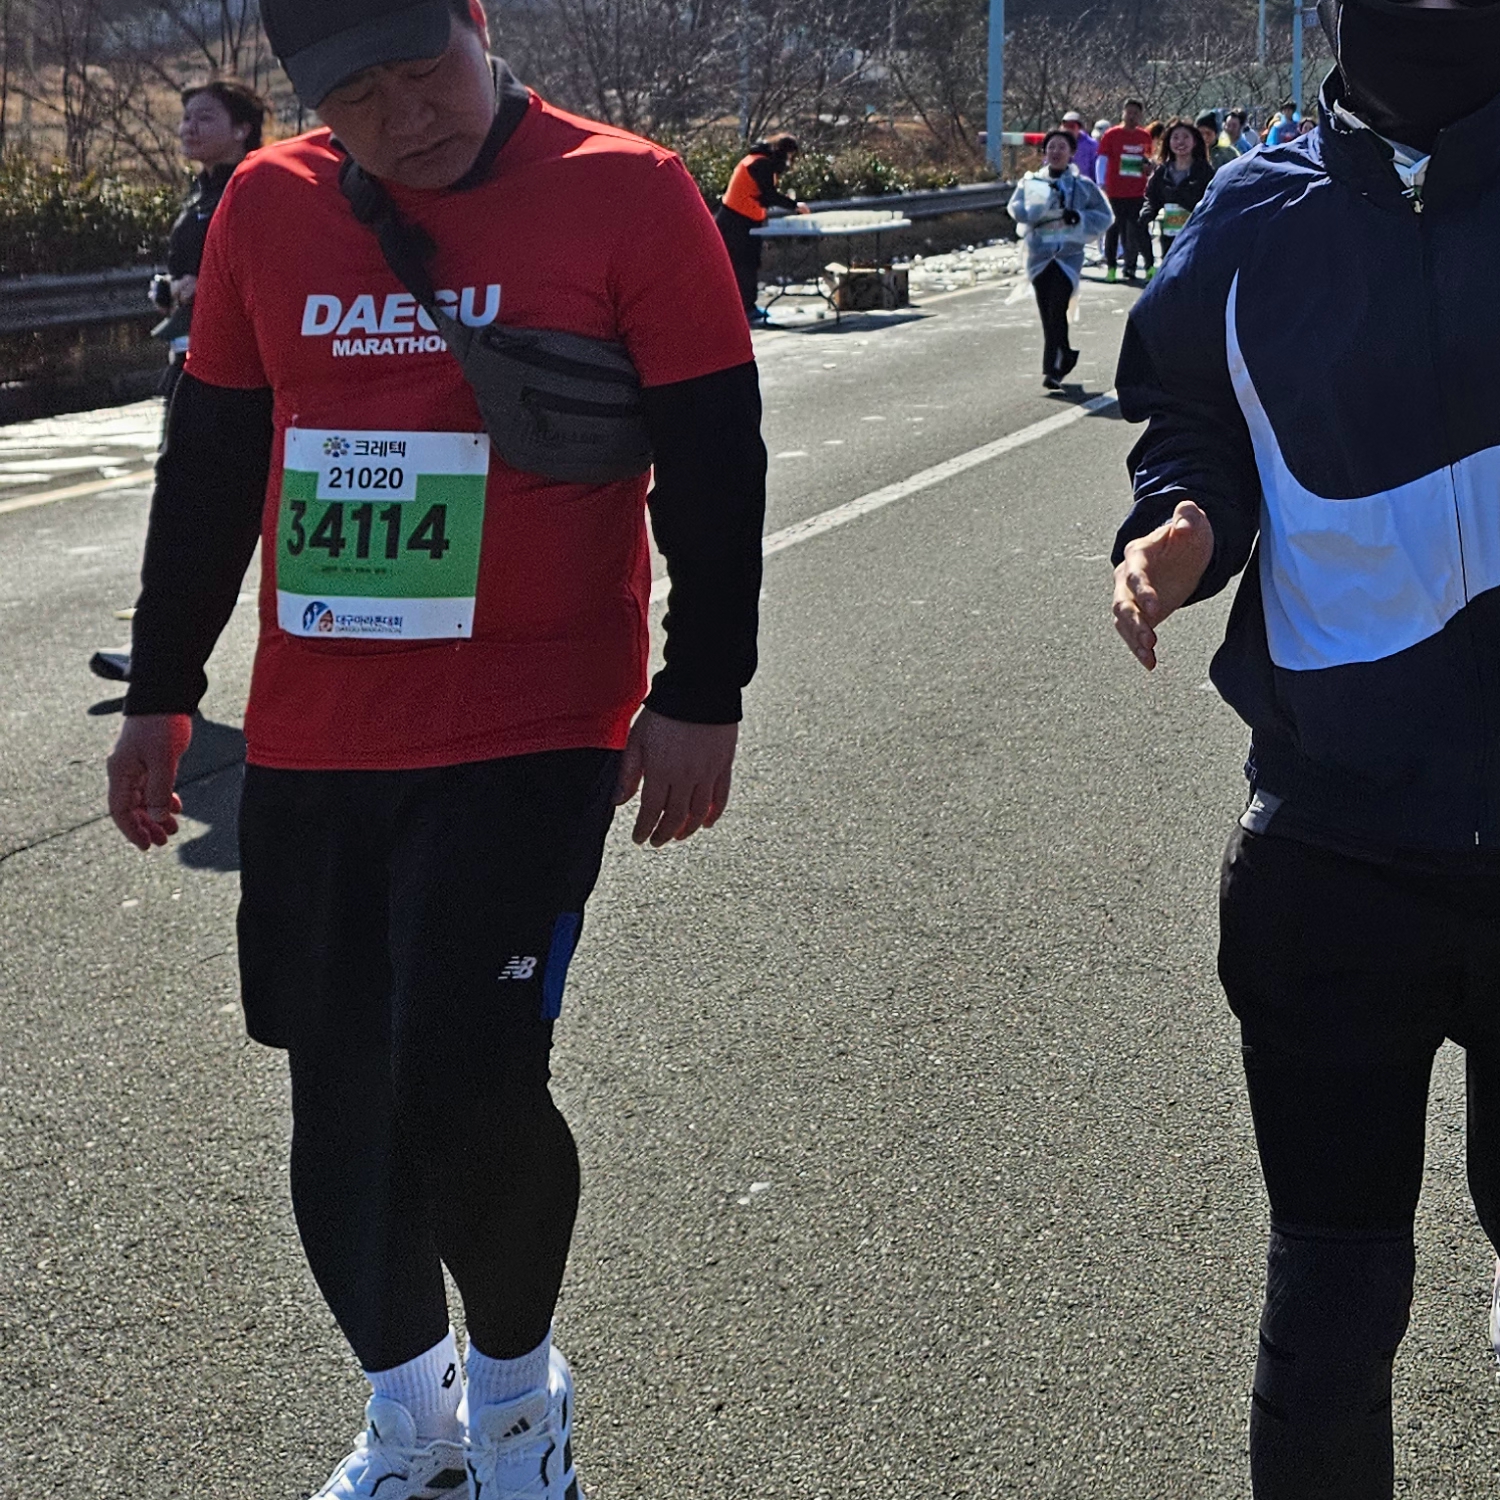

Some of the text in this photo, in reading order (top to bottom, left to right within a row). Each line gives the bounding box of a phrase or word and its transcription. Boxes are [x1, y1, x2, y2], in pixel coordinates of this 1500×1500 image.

[353, 440, 407, 458] 크레텍
[329, 467, 404, 489] 21020
[287, 500, 450, 560] 34114
